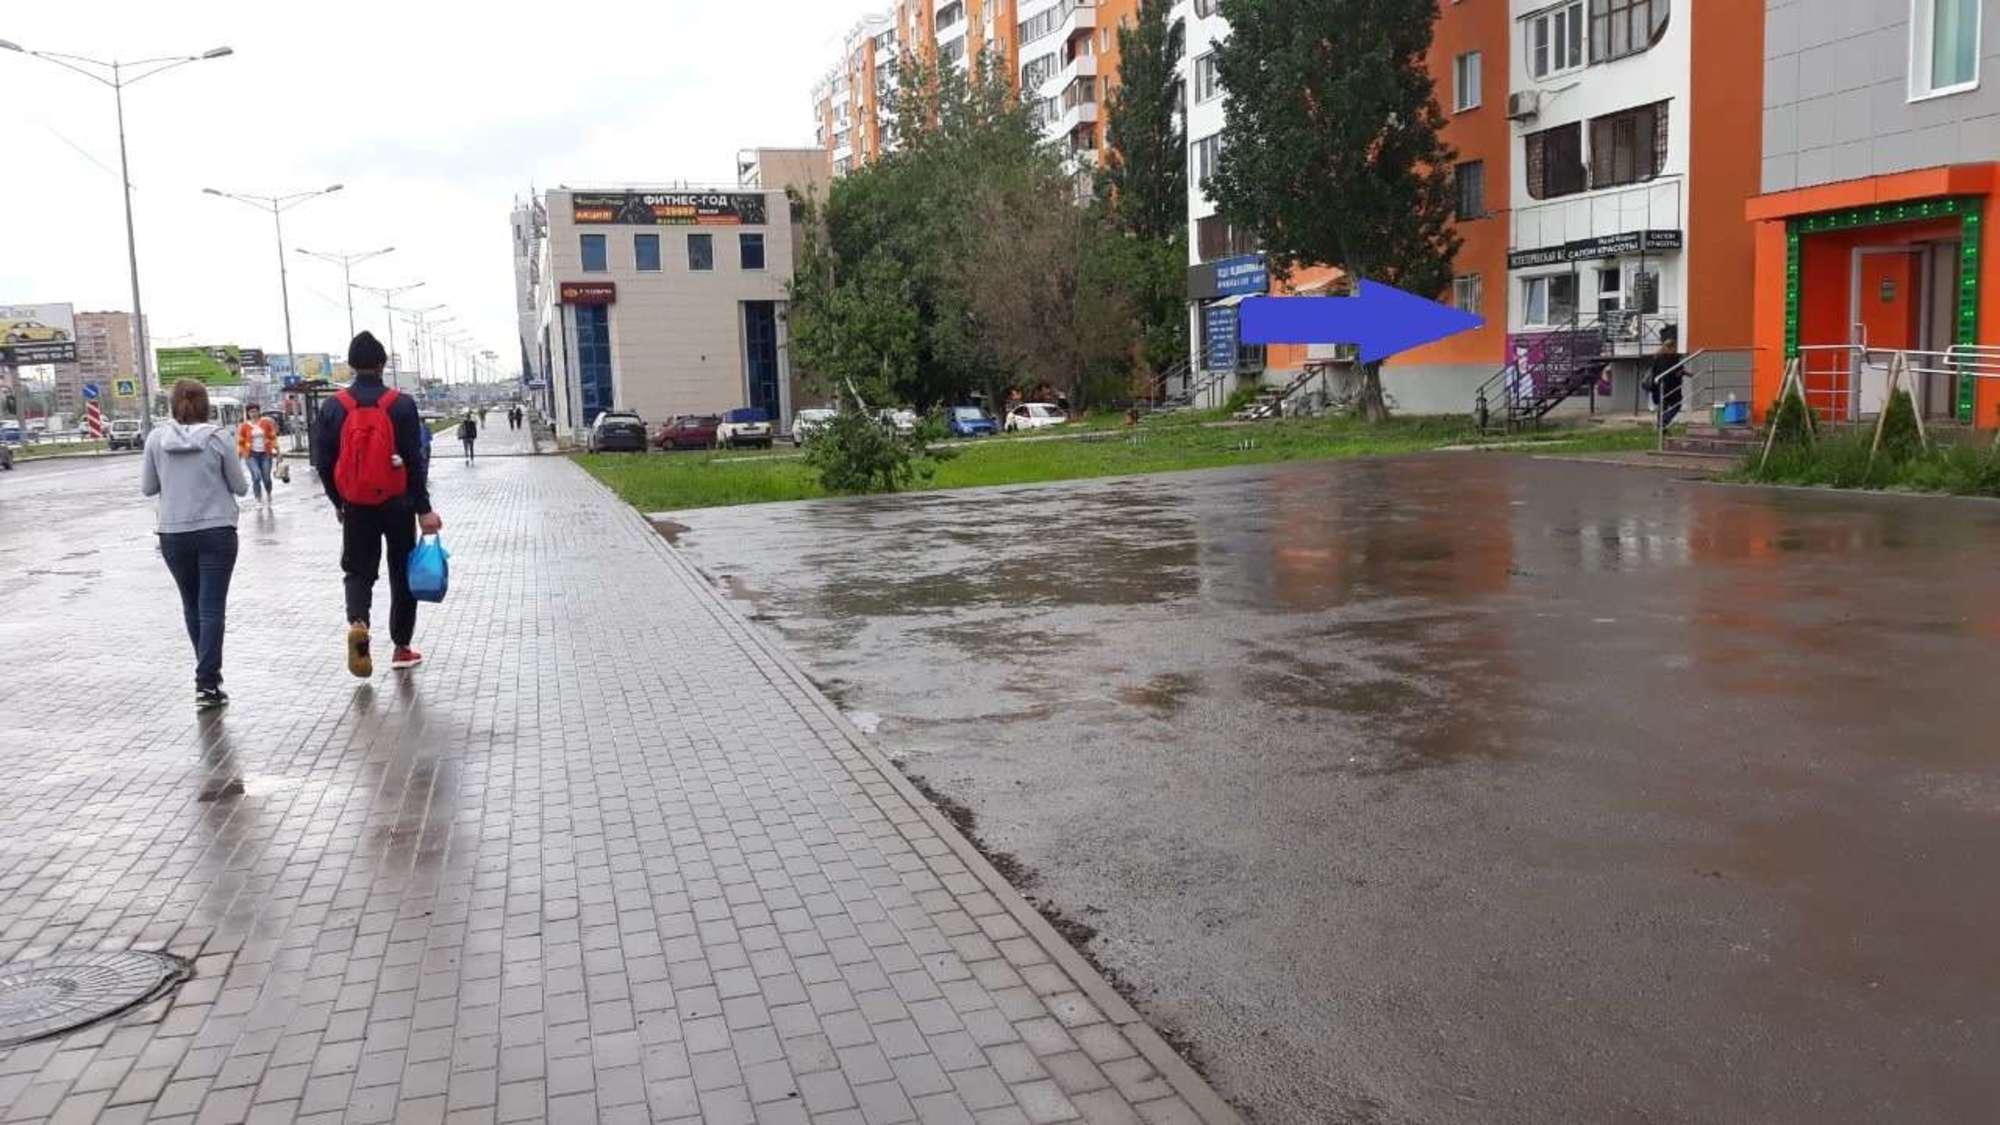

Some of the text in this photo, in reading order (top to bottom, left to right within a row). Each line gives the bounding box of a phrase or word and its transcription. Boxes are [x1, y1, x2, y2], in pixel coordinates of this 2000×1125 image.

[643, 194, 728, 206] ФИТНЕС-ГОД
[1650, 232, 1676, 240] САЛОН
[1646, 240, 1680, 248] КРАСОТЫ
[1567, 246, 1598, 259] САЛОН
[1599, 241, 1638, 254] КРАСОТЫ
